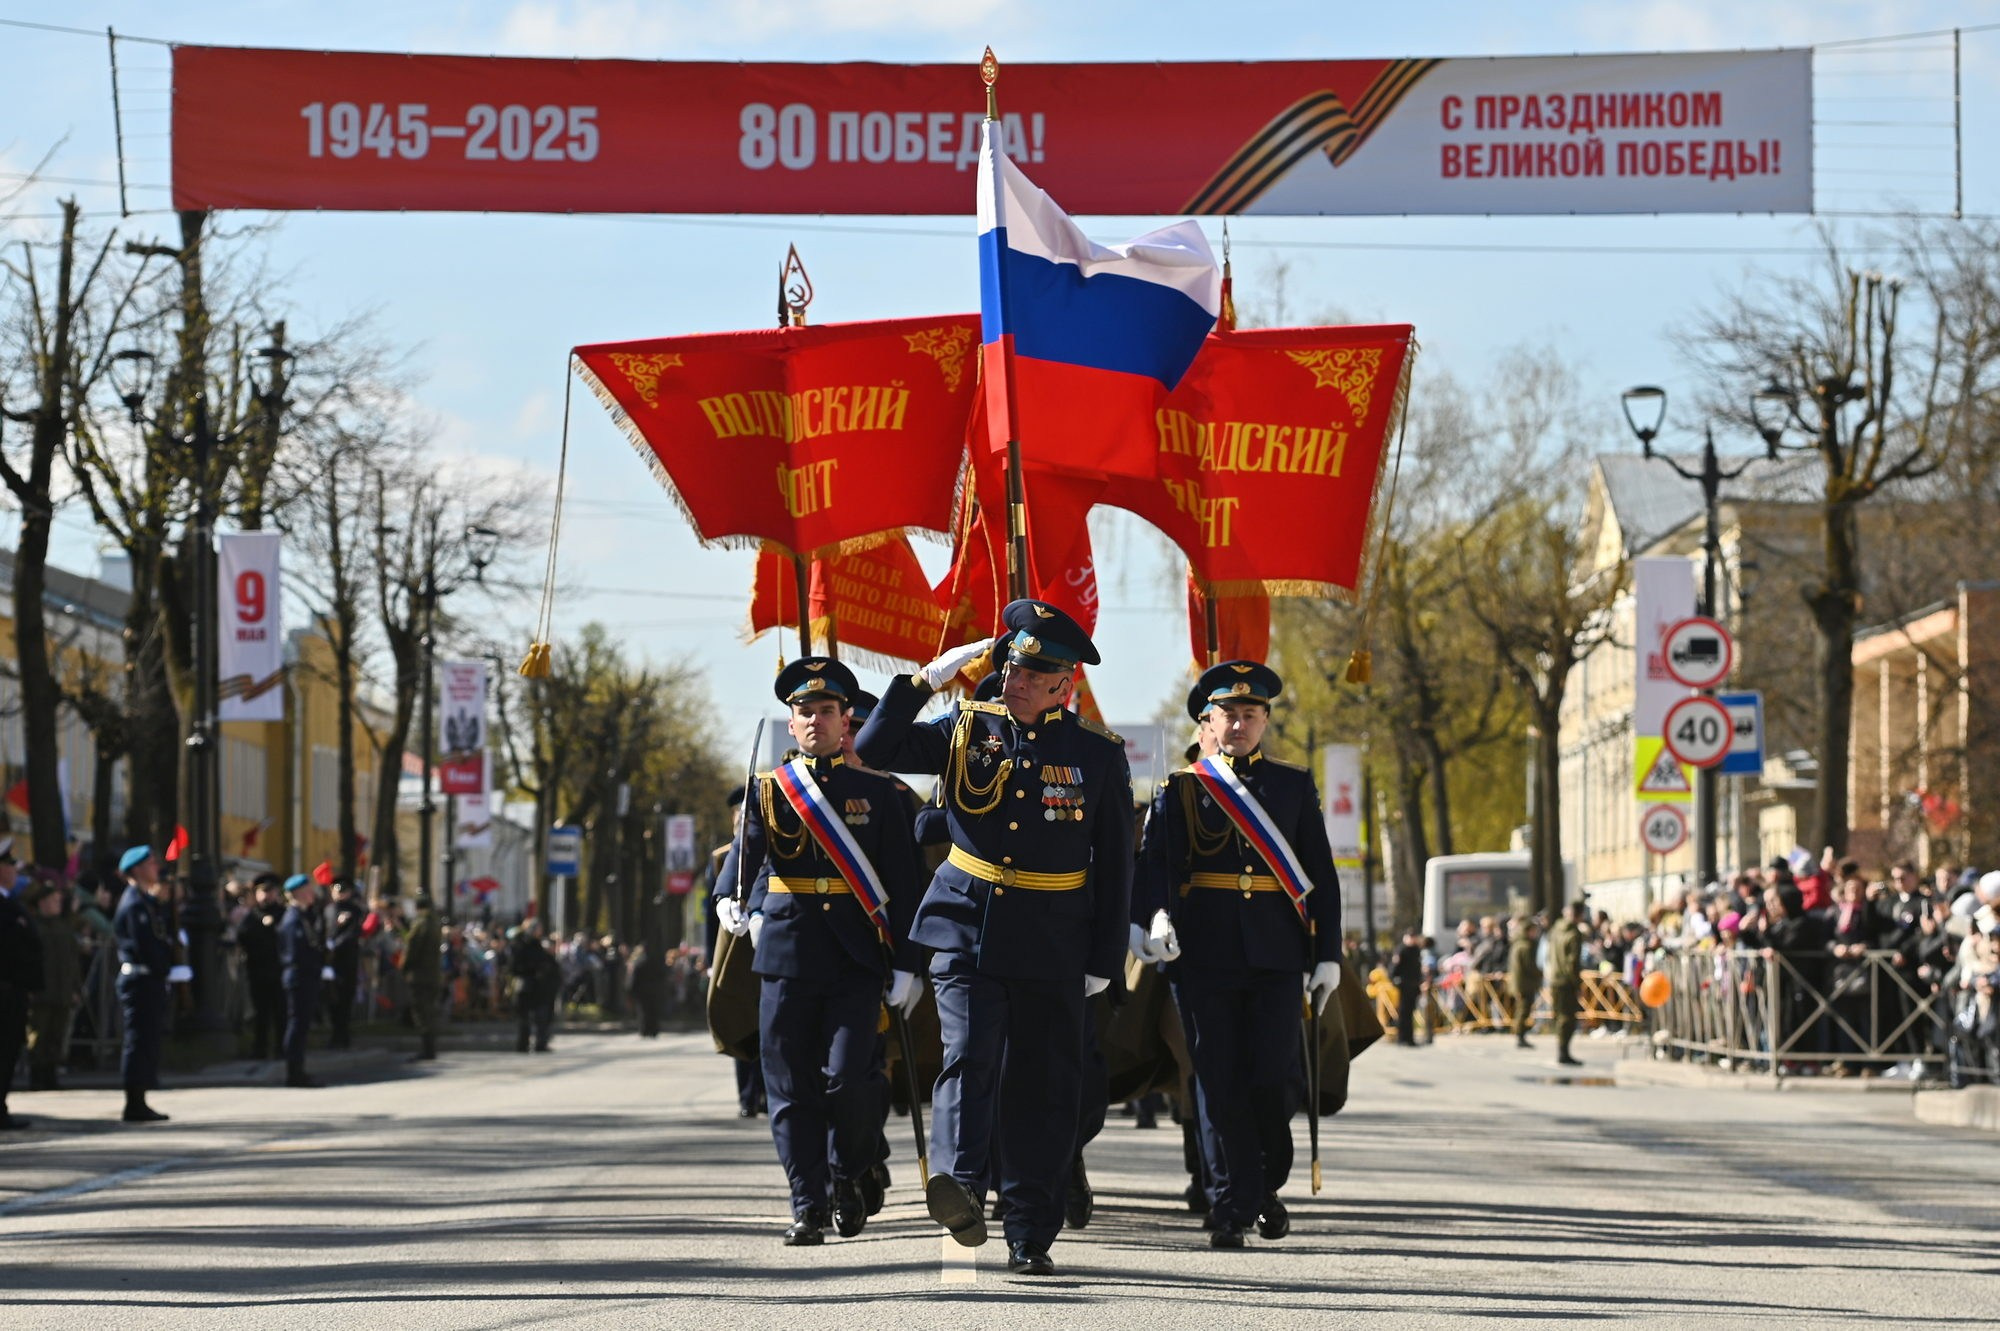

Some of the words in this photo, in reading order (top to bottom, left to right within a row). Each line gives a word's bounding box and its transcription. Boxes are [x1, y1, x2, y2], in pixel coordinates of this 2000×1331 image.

[1440, 95, 1463, 131] С
[1475, 91, 1722, 135] ПРАЗДНИКОМ
[739, 102, 816, 171] 80
[1441, 138, 1605, 179] ВЕЛИКОЙ
[1617, 140, 1781, 182] ПОБЕДЫ!
[1155, 408, 1349, 478] НГРАДСКИЙ
[845, 556, 903, 588] ПОЛК
[234, 569, 267, 624] 9
[918, 625, 942, 647] СВ
[1676, 716, 1720, 746] 40
[1649, 819, 1679, 835] 40
